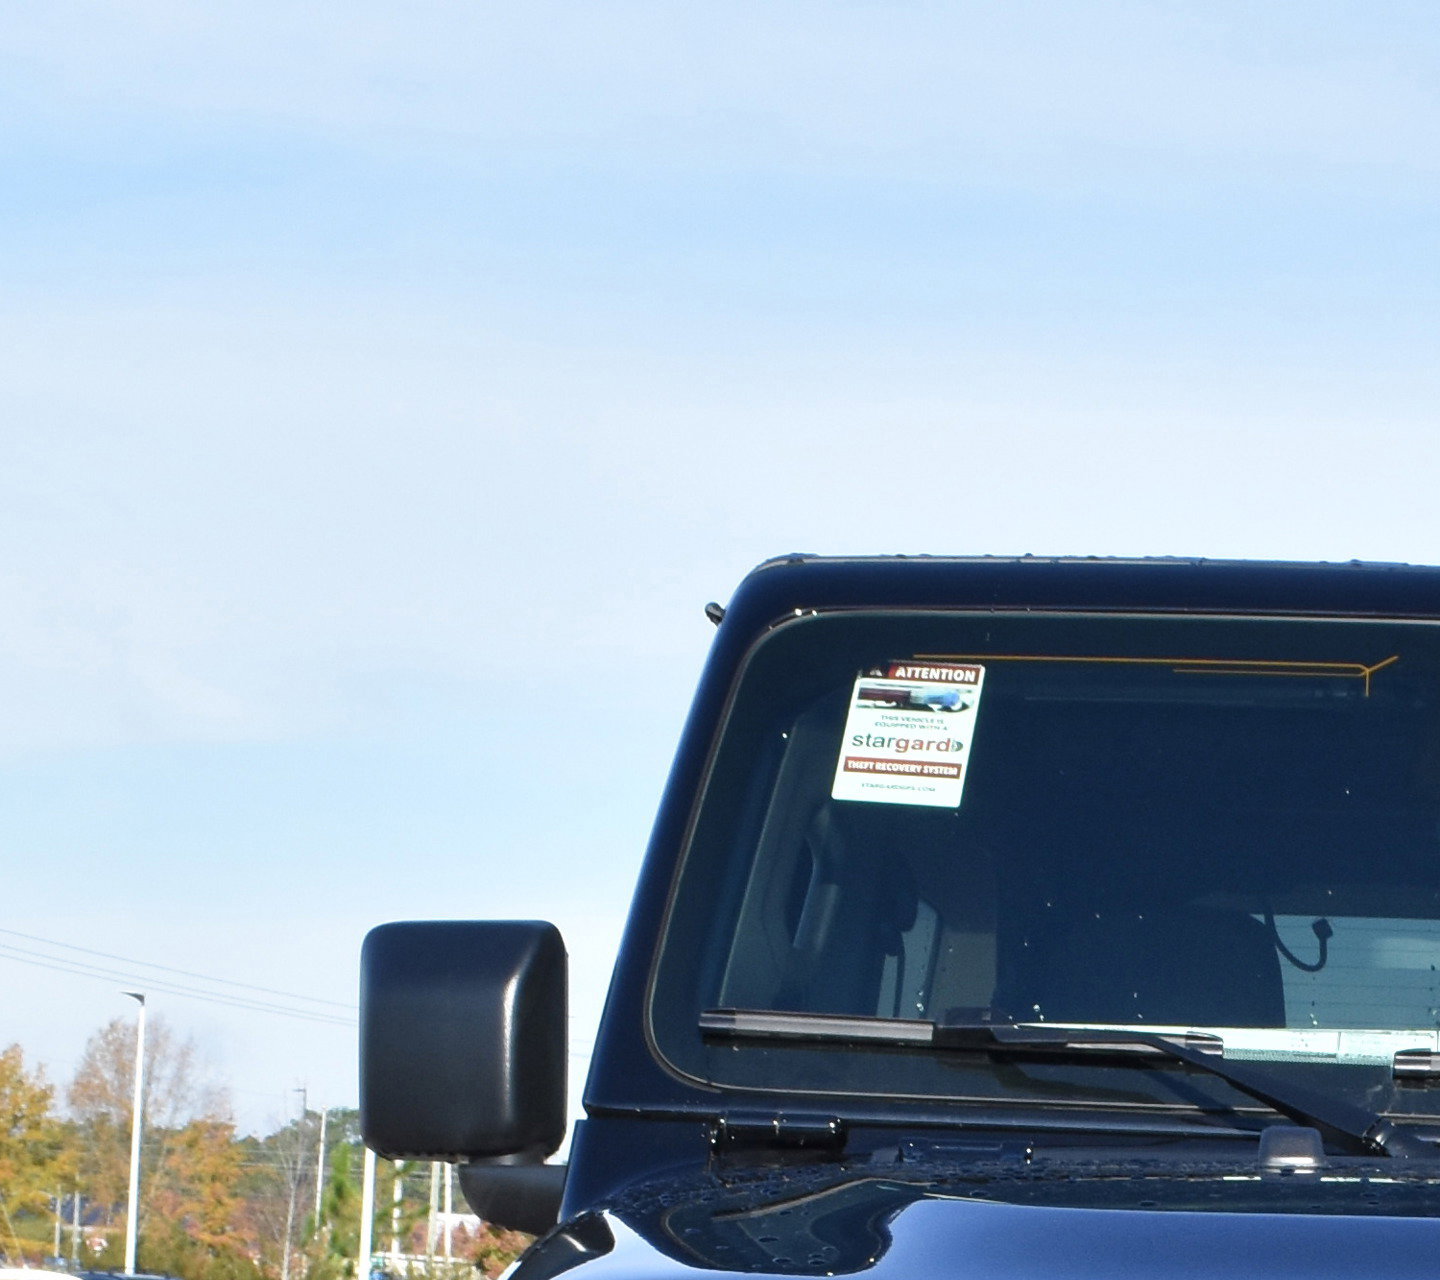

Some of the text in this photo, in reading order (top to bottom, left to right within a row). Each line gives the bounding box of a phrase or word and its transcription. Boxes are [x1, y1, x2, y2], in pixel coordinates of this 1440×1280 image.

[895, 667, 976, 682] ATTENTION
[851, 733, 950, 753] stargard
[847, 760, 958, 776] THEFT RECOVERY SYSTEM
